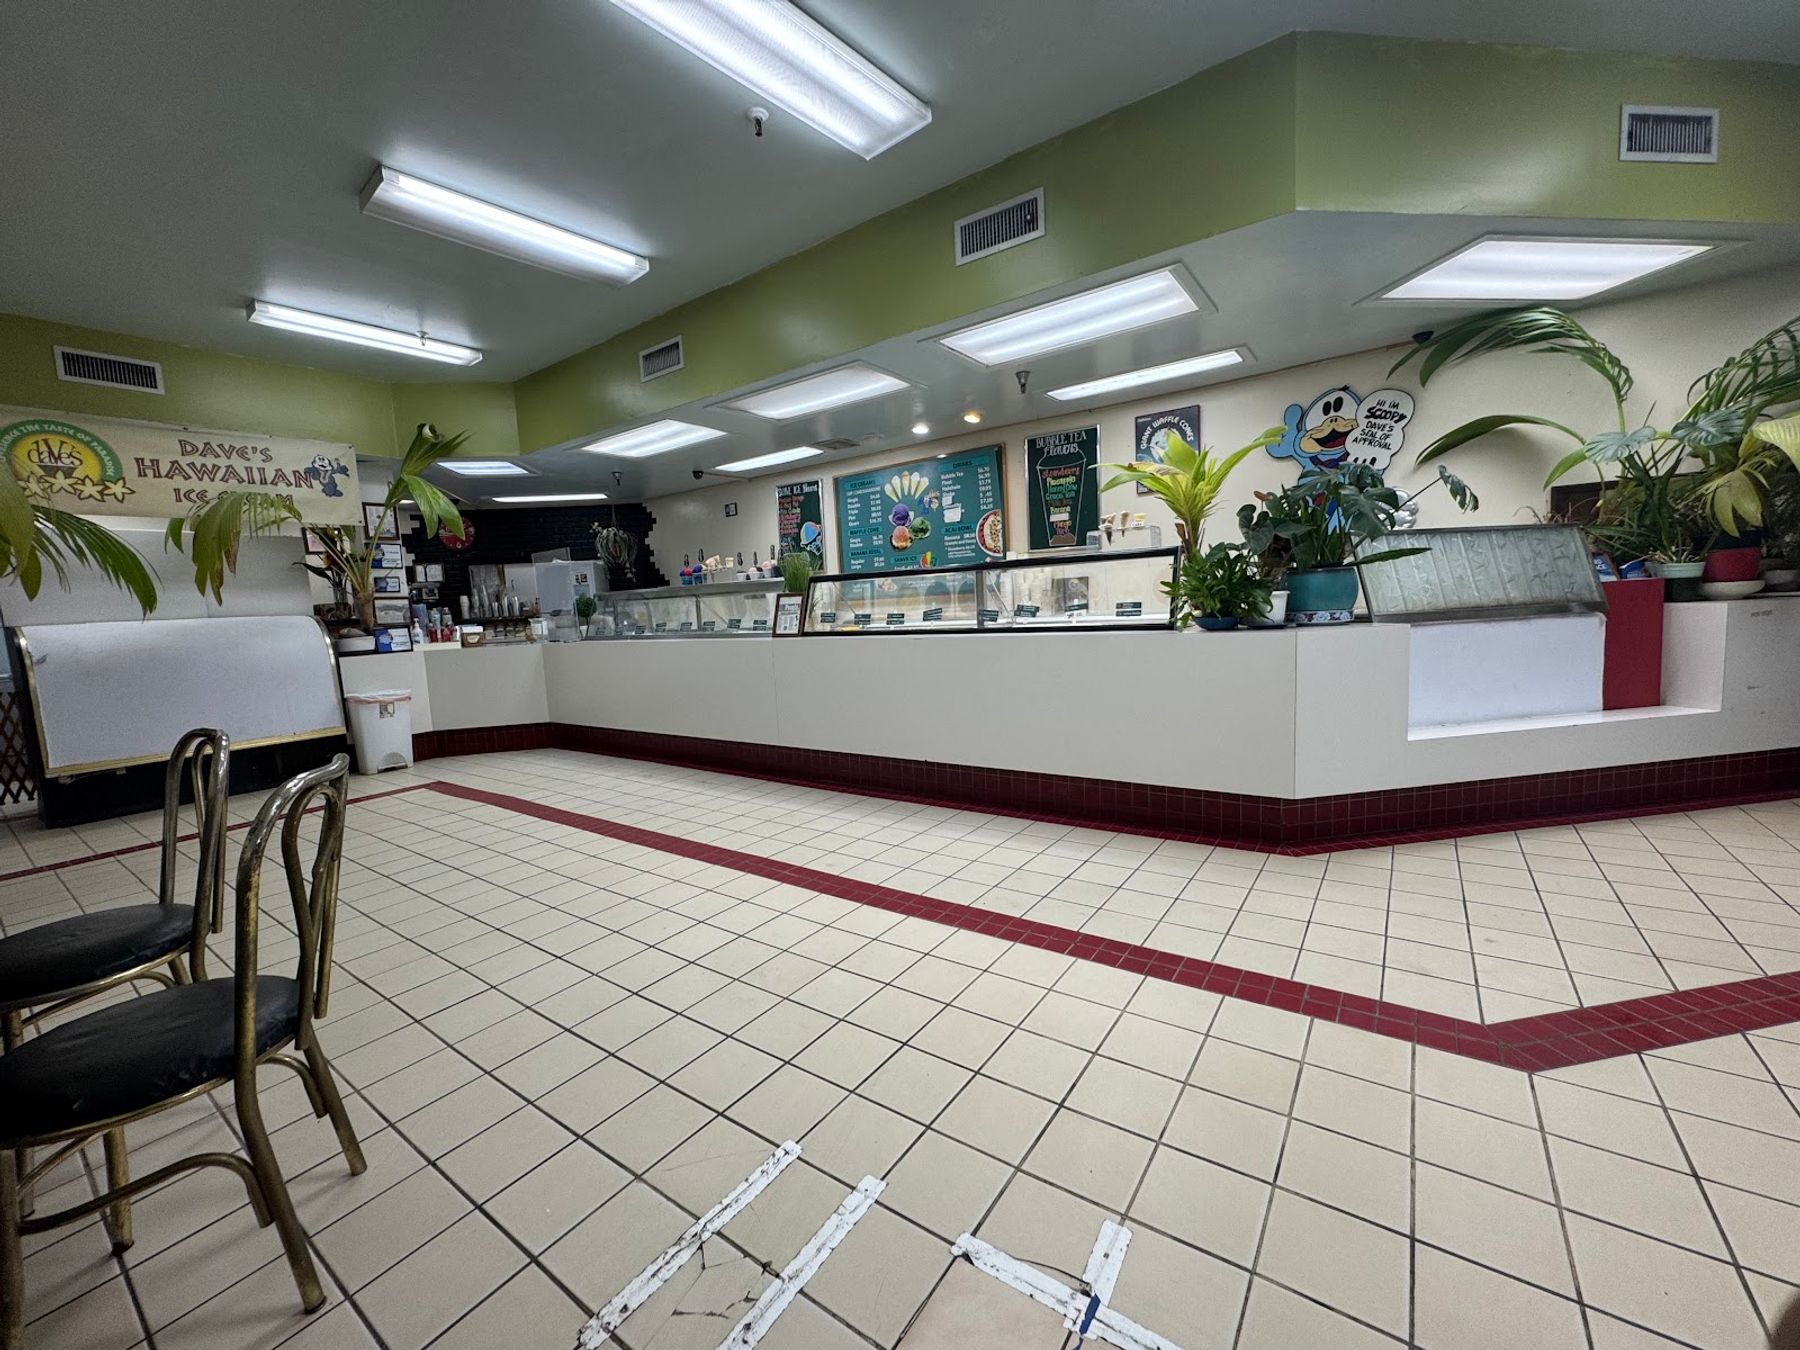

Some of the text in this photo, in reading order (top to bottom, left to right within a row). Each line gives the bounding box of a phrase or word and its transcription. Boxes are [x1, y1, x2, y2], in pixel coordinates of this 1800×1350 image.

[1376, 399, 1386, 407] HI
[1364, 405, 1407, 424] SCOOPY
[43, 424, 75, 436] TASTE
[76, 432, 92, 442] OF
[1036, 430, 1087, 449] BUBBLE TEA
[1140, 415, 1194, 450] GIANT WAFFLE CONES
[1360, 428, 1392, 441] SEAL OF
[178, 438, 274, 463] DAVE'S
[1352, 436, 1392, 450] APPROVAL
[134, 457, 313, 489] HAWAIIAN
[173, 488, 209, 504] ICE
